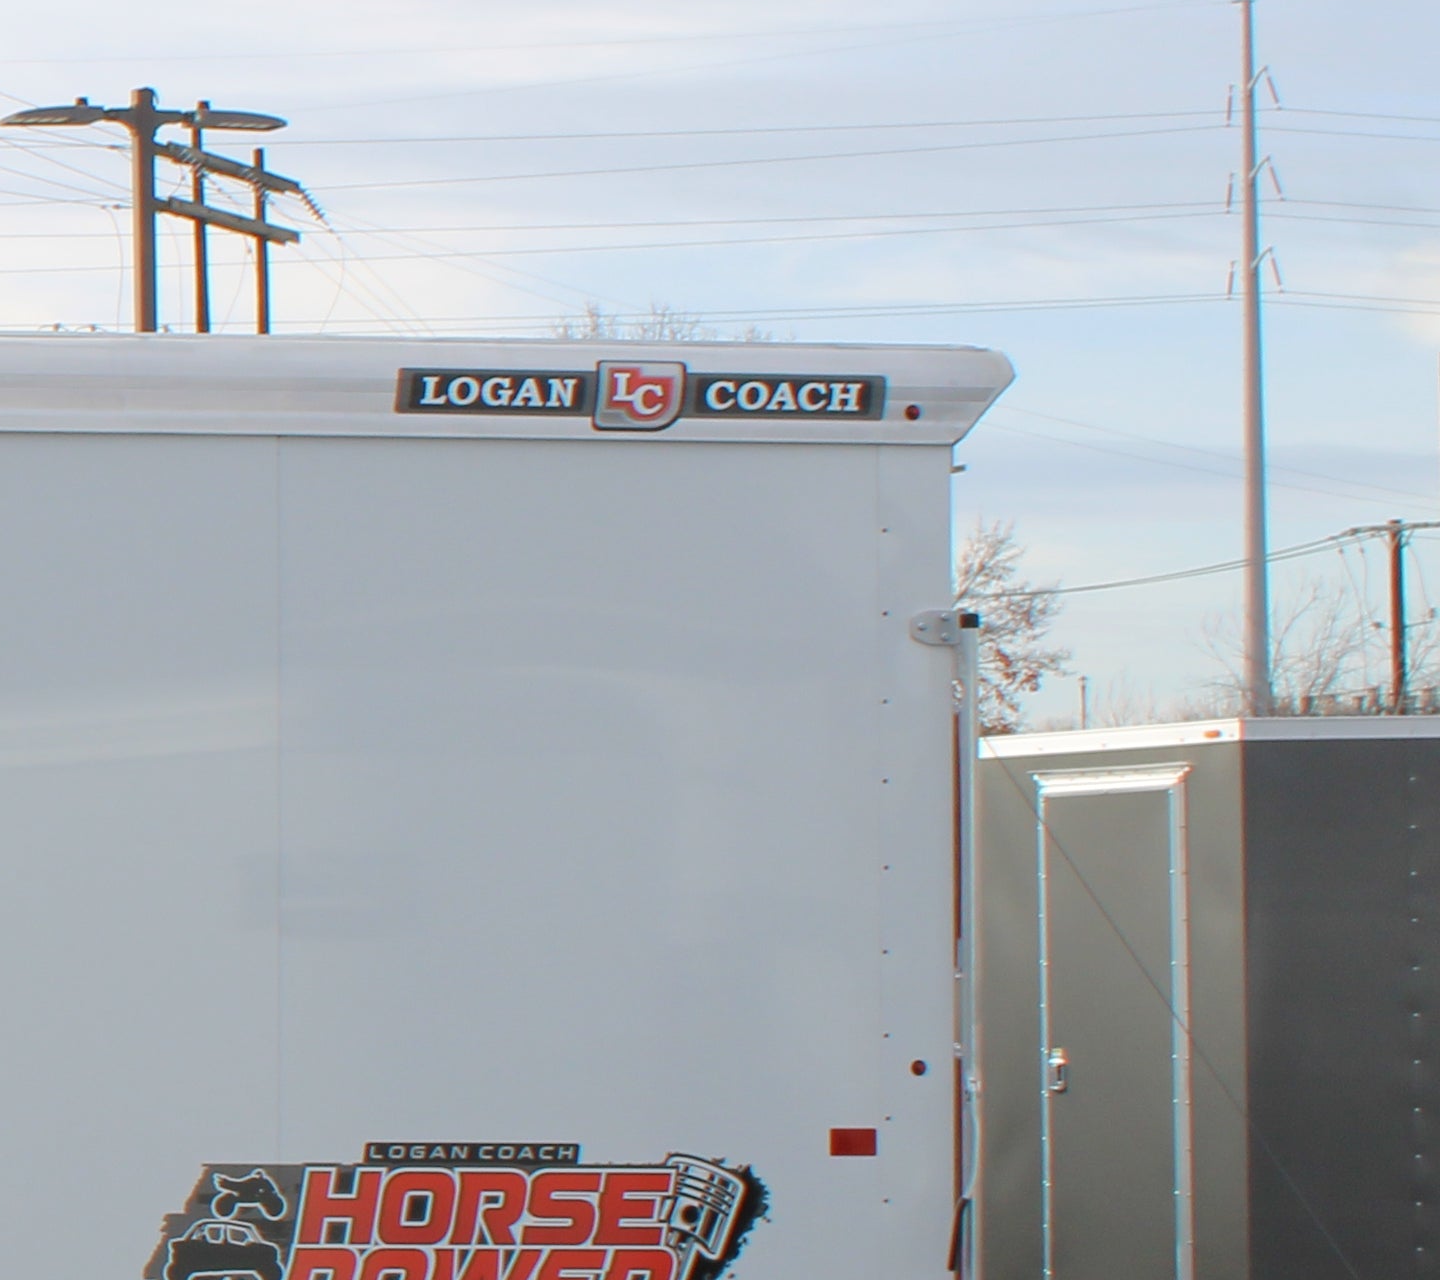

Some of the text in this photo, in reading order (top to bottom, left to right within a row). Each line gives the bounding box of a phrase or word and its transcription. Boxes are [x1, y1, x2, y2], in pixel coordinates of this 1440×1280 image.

[419, 372, 865, 416] LOGAN LC COACH
[369, 1144, 577, 1162] LOGAN COACH
[296, 1166, 678, 1246] HORSE
